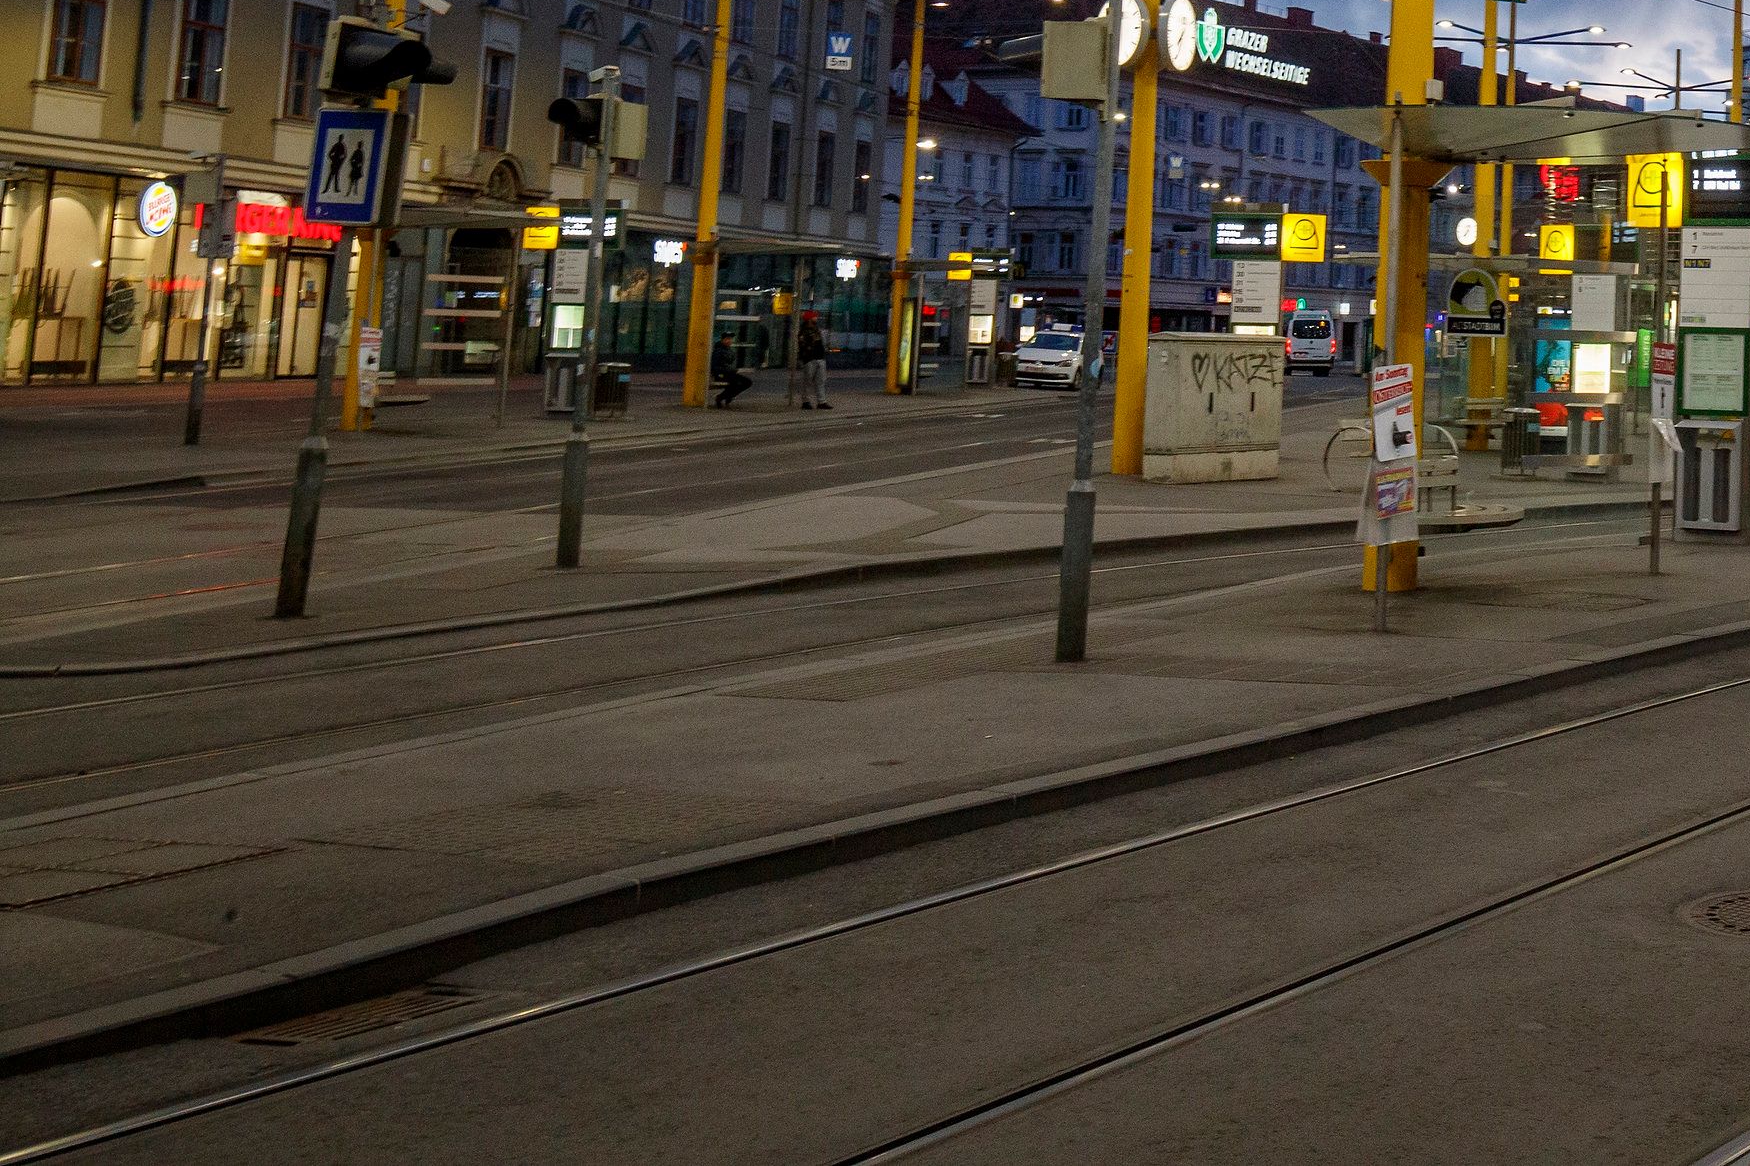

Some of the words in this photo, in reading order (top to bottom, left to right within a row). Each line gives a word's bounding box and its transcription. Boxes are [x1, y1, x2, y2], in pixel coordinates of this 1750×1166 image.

[830, 36, 851, 53] W
[1226, 27, 1269, 53] GRAZER
[1224, 49, 1311, 86] WECHSELSEITIGE
